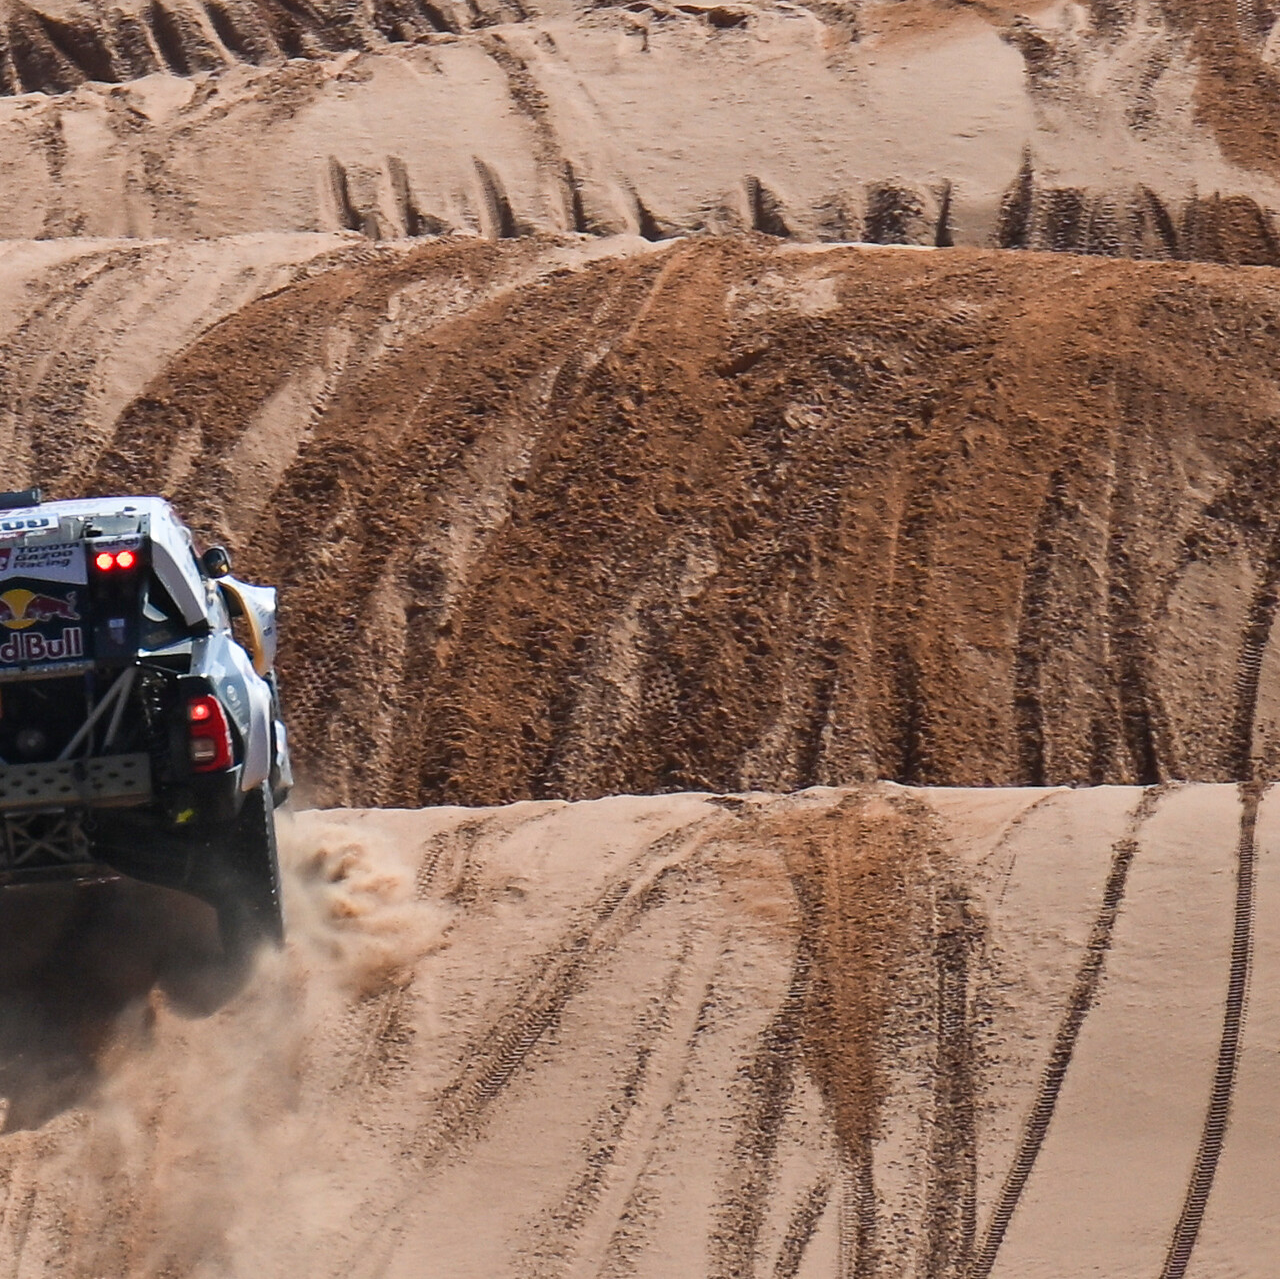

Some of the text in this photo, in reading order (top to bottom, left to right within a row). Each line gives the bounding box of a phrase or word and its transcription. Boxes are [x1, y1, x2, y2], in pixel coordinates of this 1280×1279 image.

[17, 541, 80, 553] TOYOTA
[15, 550, 74, 561] GAZOO
[13, 558, 71, 569] Racing
[22, 627, 83, 660] Bull
